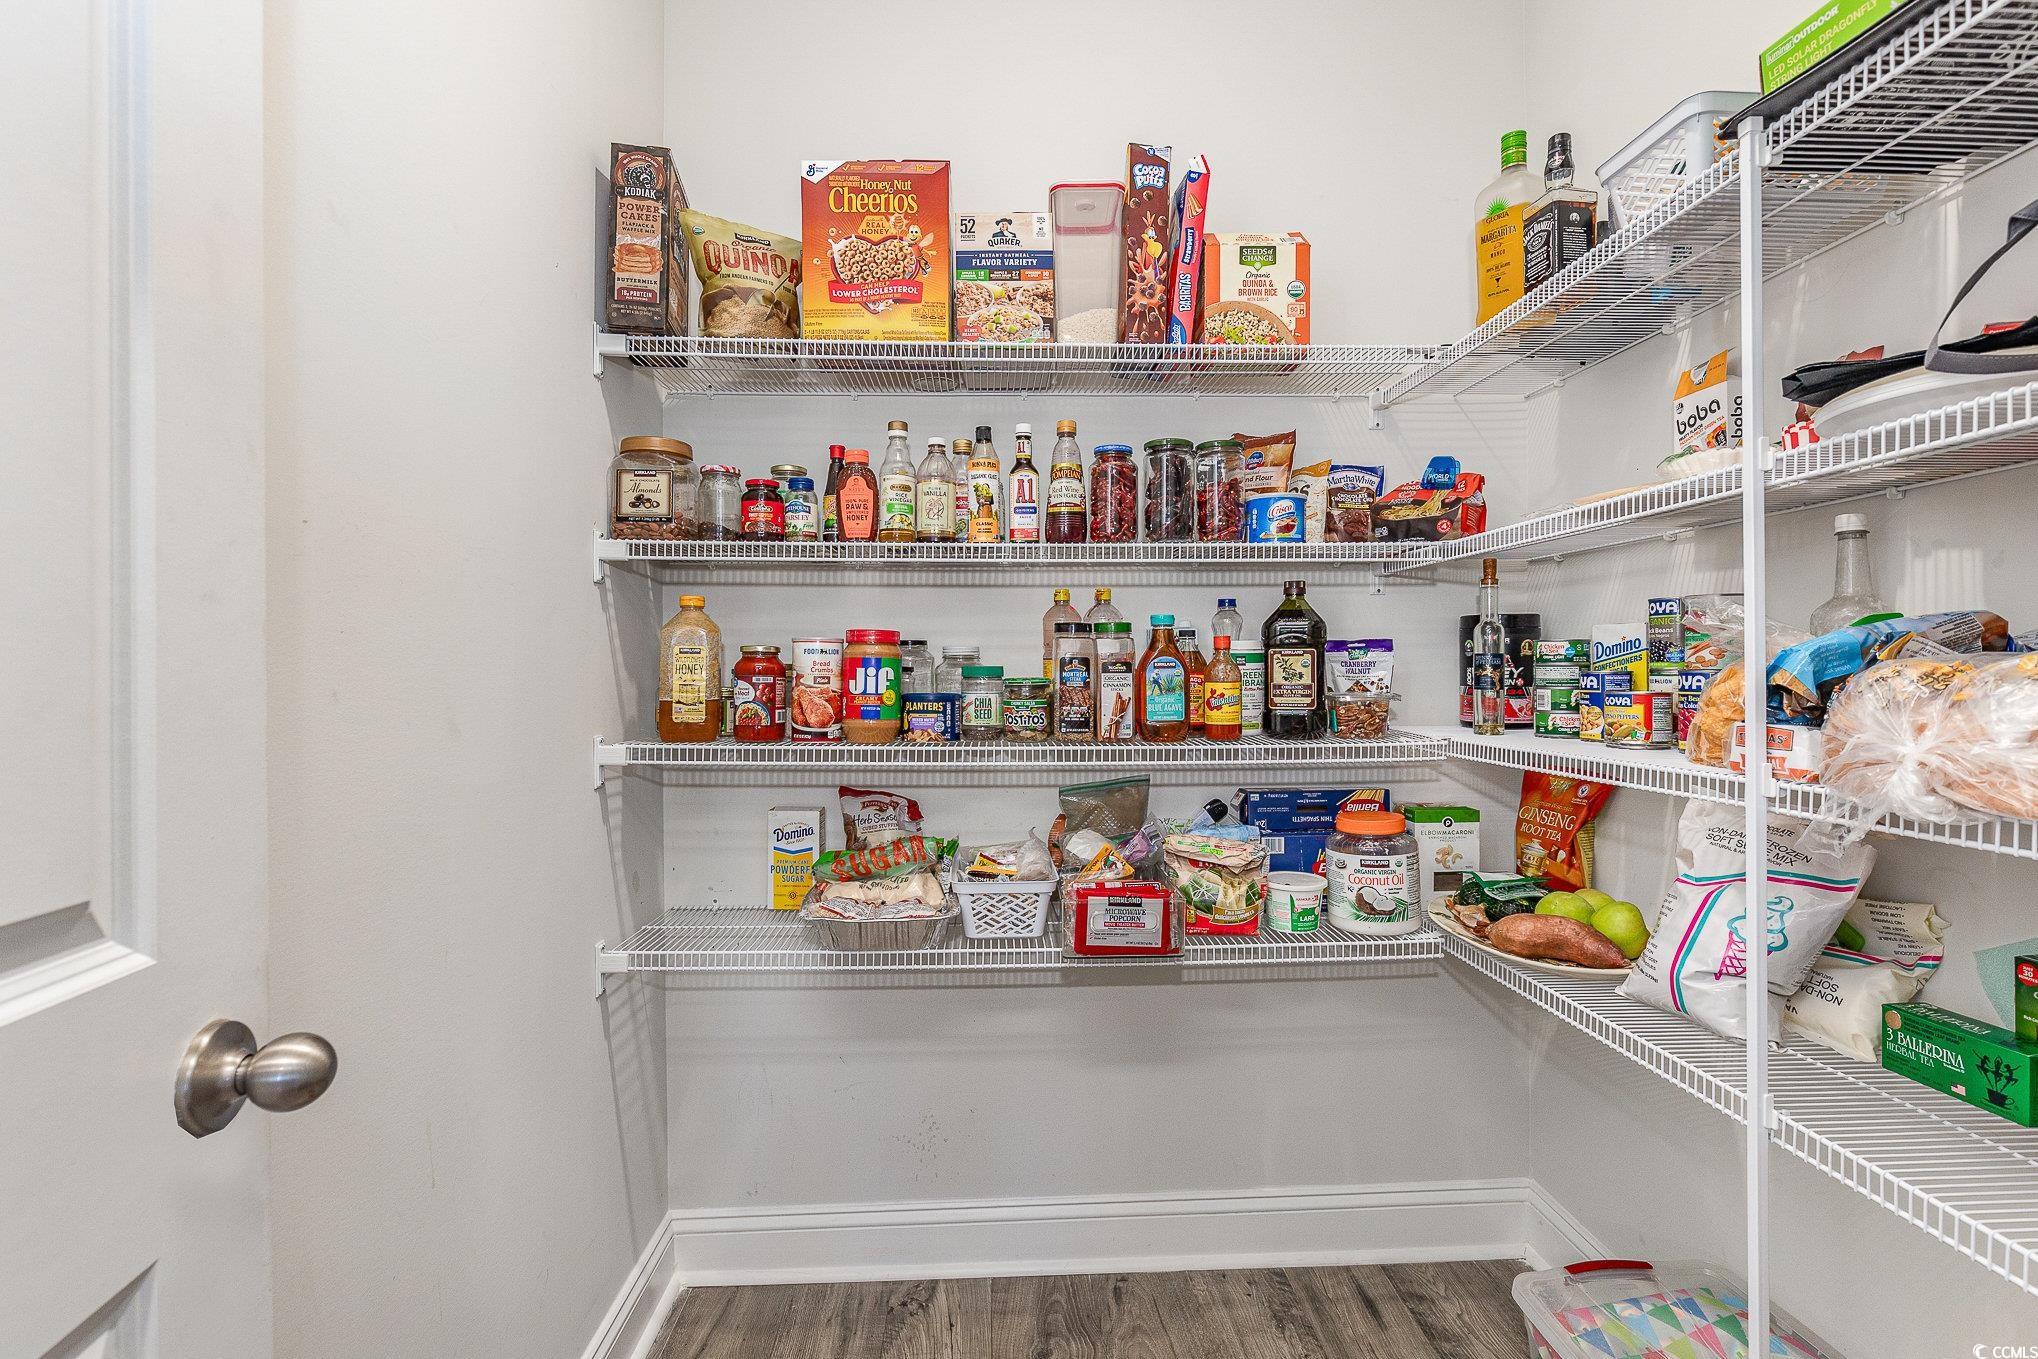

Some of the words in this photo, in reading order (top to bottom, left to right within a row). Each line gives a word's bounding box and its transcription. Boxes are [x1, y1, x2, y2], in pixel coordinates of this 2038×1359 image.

[1793, 4, 1840, 43] OUTDOOR
[1769, 63, 1786, 80] LED
[1787, 40, 1818, 67] SOLAR
[1819, 0, 1877, 45] DRAGONFLY
[1770, 64, 1803, 91] STRING
[1805, 42, 1833, 67] LIGHT
[860, 179, 891, 193] Honey
[893, 179, 912, 191] Nut
[624, 186, 657, 200] KODIAK
[828, 186, 918, 214] Cheerios
[618, 202, 660, 214] POWER
[620, 211, 661, 223] CAKES
[865, 221, 886, 229] REAL
[960, 218, 976, 234] 52
[1480, 225, 1517, 245] MARGARITA
[987, 237, 1021, 248] QUAKER
[703, 239, 799, 284] QUINOA
[972, 258, 1002, 266] FLAVOR
[1003, 258, 1038, 266] VARIETY
[616, 277, 658, 285] BUTTERMILK
[1245, 271, 1271, 279] Organic
[1242, 280, 1266, 288] QUINOA
[1269, 280, 1274, 288] &
[832, 289, 861, 297] LOWER
[862, 286, 919, 298] CHOLESTEROL
[1179, 273, 1193, 312] BARRITAS
[1238, 288, 1263, 297] BROWN
[1264, 288, 1278, 297] RICE
[1676, 398, 1721, 435] boba
[1255, 474, 1274, 482] Flour
[1327, 475, 1354, 487] Martha
[1354, 474, 1377, 487] White
[623, 482, 662, 494] Almonds
[1270, 504, 1293, 517] Crisco
[1649, 601, 1678, 614] OYA
[1594, 638, 1642, 660] Domino
[675, 663, 704, 675] HONEY
[1593, 654, 1643, 672] CONFECTIONERS
[848, 666, 895, 695] Jif
[905, 702, 944, 711] PLANTERS
[974, 697, 992, 709] CHIA
[1164, 703, 1182, 711] AGAVE
[974, 709, 992, 719] SEED
[1004, 713, 1046, 727] TOSTITOS
[853, 813, 873, 827] Herb
[1519, 805, 1577, 831] GINSENG
[773, 825, 814, 842] Domino
[1520, 822, 1546, 837] ROOT
[1546, 829, 1562, 842] TEA
[1706, 833, 1735, 845] SOFT
[1709, 841, 1733, 852] NATURAL
[831, 835, 928, 883] SUGAR
[1773, 852, 1798, 867] MIX
[770, 865, 810, 874] POWDERE
[1348, 874, 1390, 885] Coconut
[1391, 873, 1404, 885] Oil
[1104, 908, 1147, 916] MICROWAVE
[1300, 914, 1315, 922] LARD
[2022, 970, 2033, 978] 30
[1807, 977, 1840, 993] SOFT
[1886, 1028, 1894, 1041] 3
[1897, 1031, 1965, 1070] BALLERINA
[1886, 1041, 1917, 1061] HERBAL
[1920, 1054, 1935, 1068] TEA
